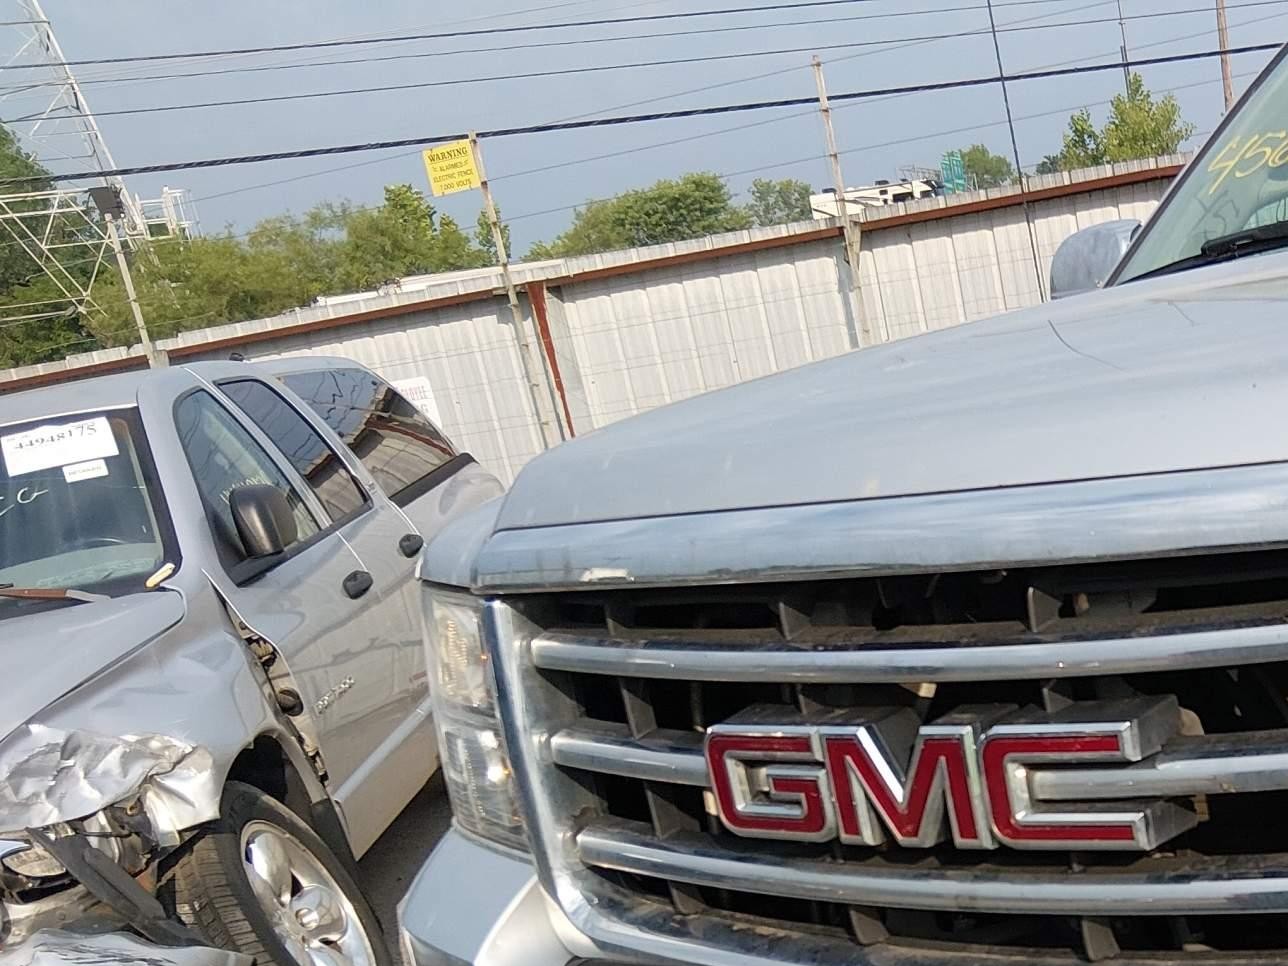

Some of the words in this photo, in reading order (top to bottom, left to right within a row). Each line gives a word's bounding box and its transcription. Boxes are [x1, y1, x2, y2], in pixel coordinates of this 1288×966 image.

[427, 146, 468, 163] WARNING
[433, 173, 456, 183] ELECTRIC
[457, 168, 474, 179] FENCE
[456, 178, 472, 188] VOLTS
[14, 422, 98, 450] 44948175
[706, 722, 1151, 850] GMC
